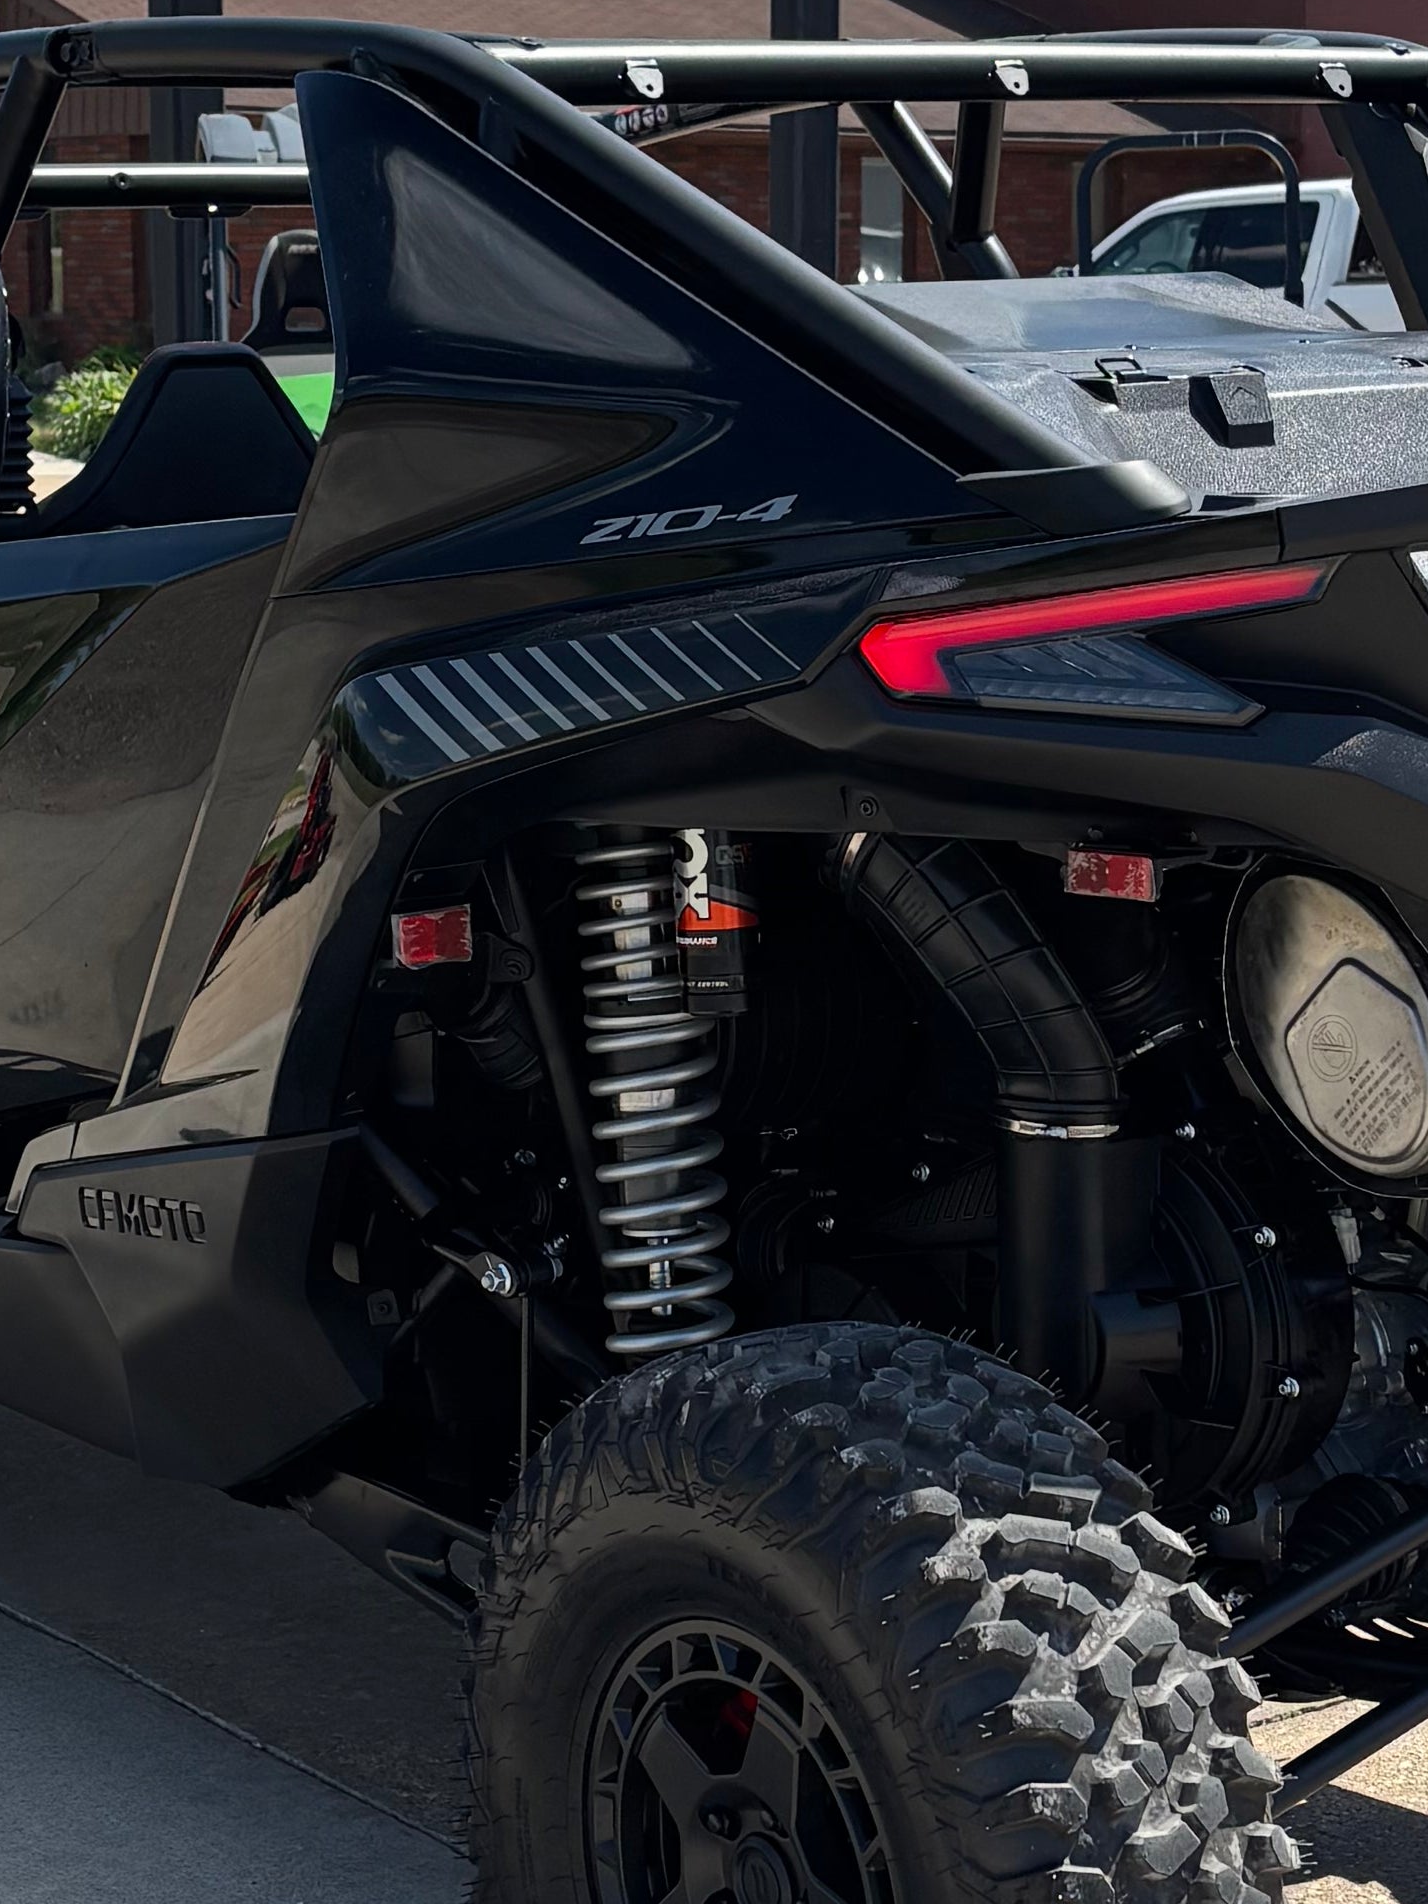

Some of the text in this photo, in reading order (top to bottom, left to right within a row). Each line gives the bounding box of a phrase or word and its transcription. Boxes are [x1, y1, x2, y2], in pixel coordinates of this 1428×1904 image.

[579, 493, 799, 545] Z10-4
[673, 828, 710, 919] OX
[78, 1186, 208, 1244] CFMOTO
